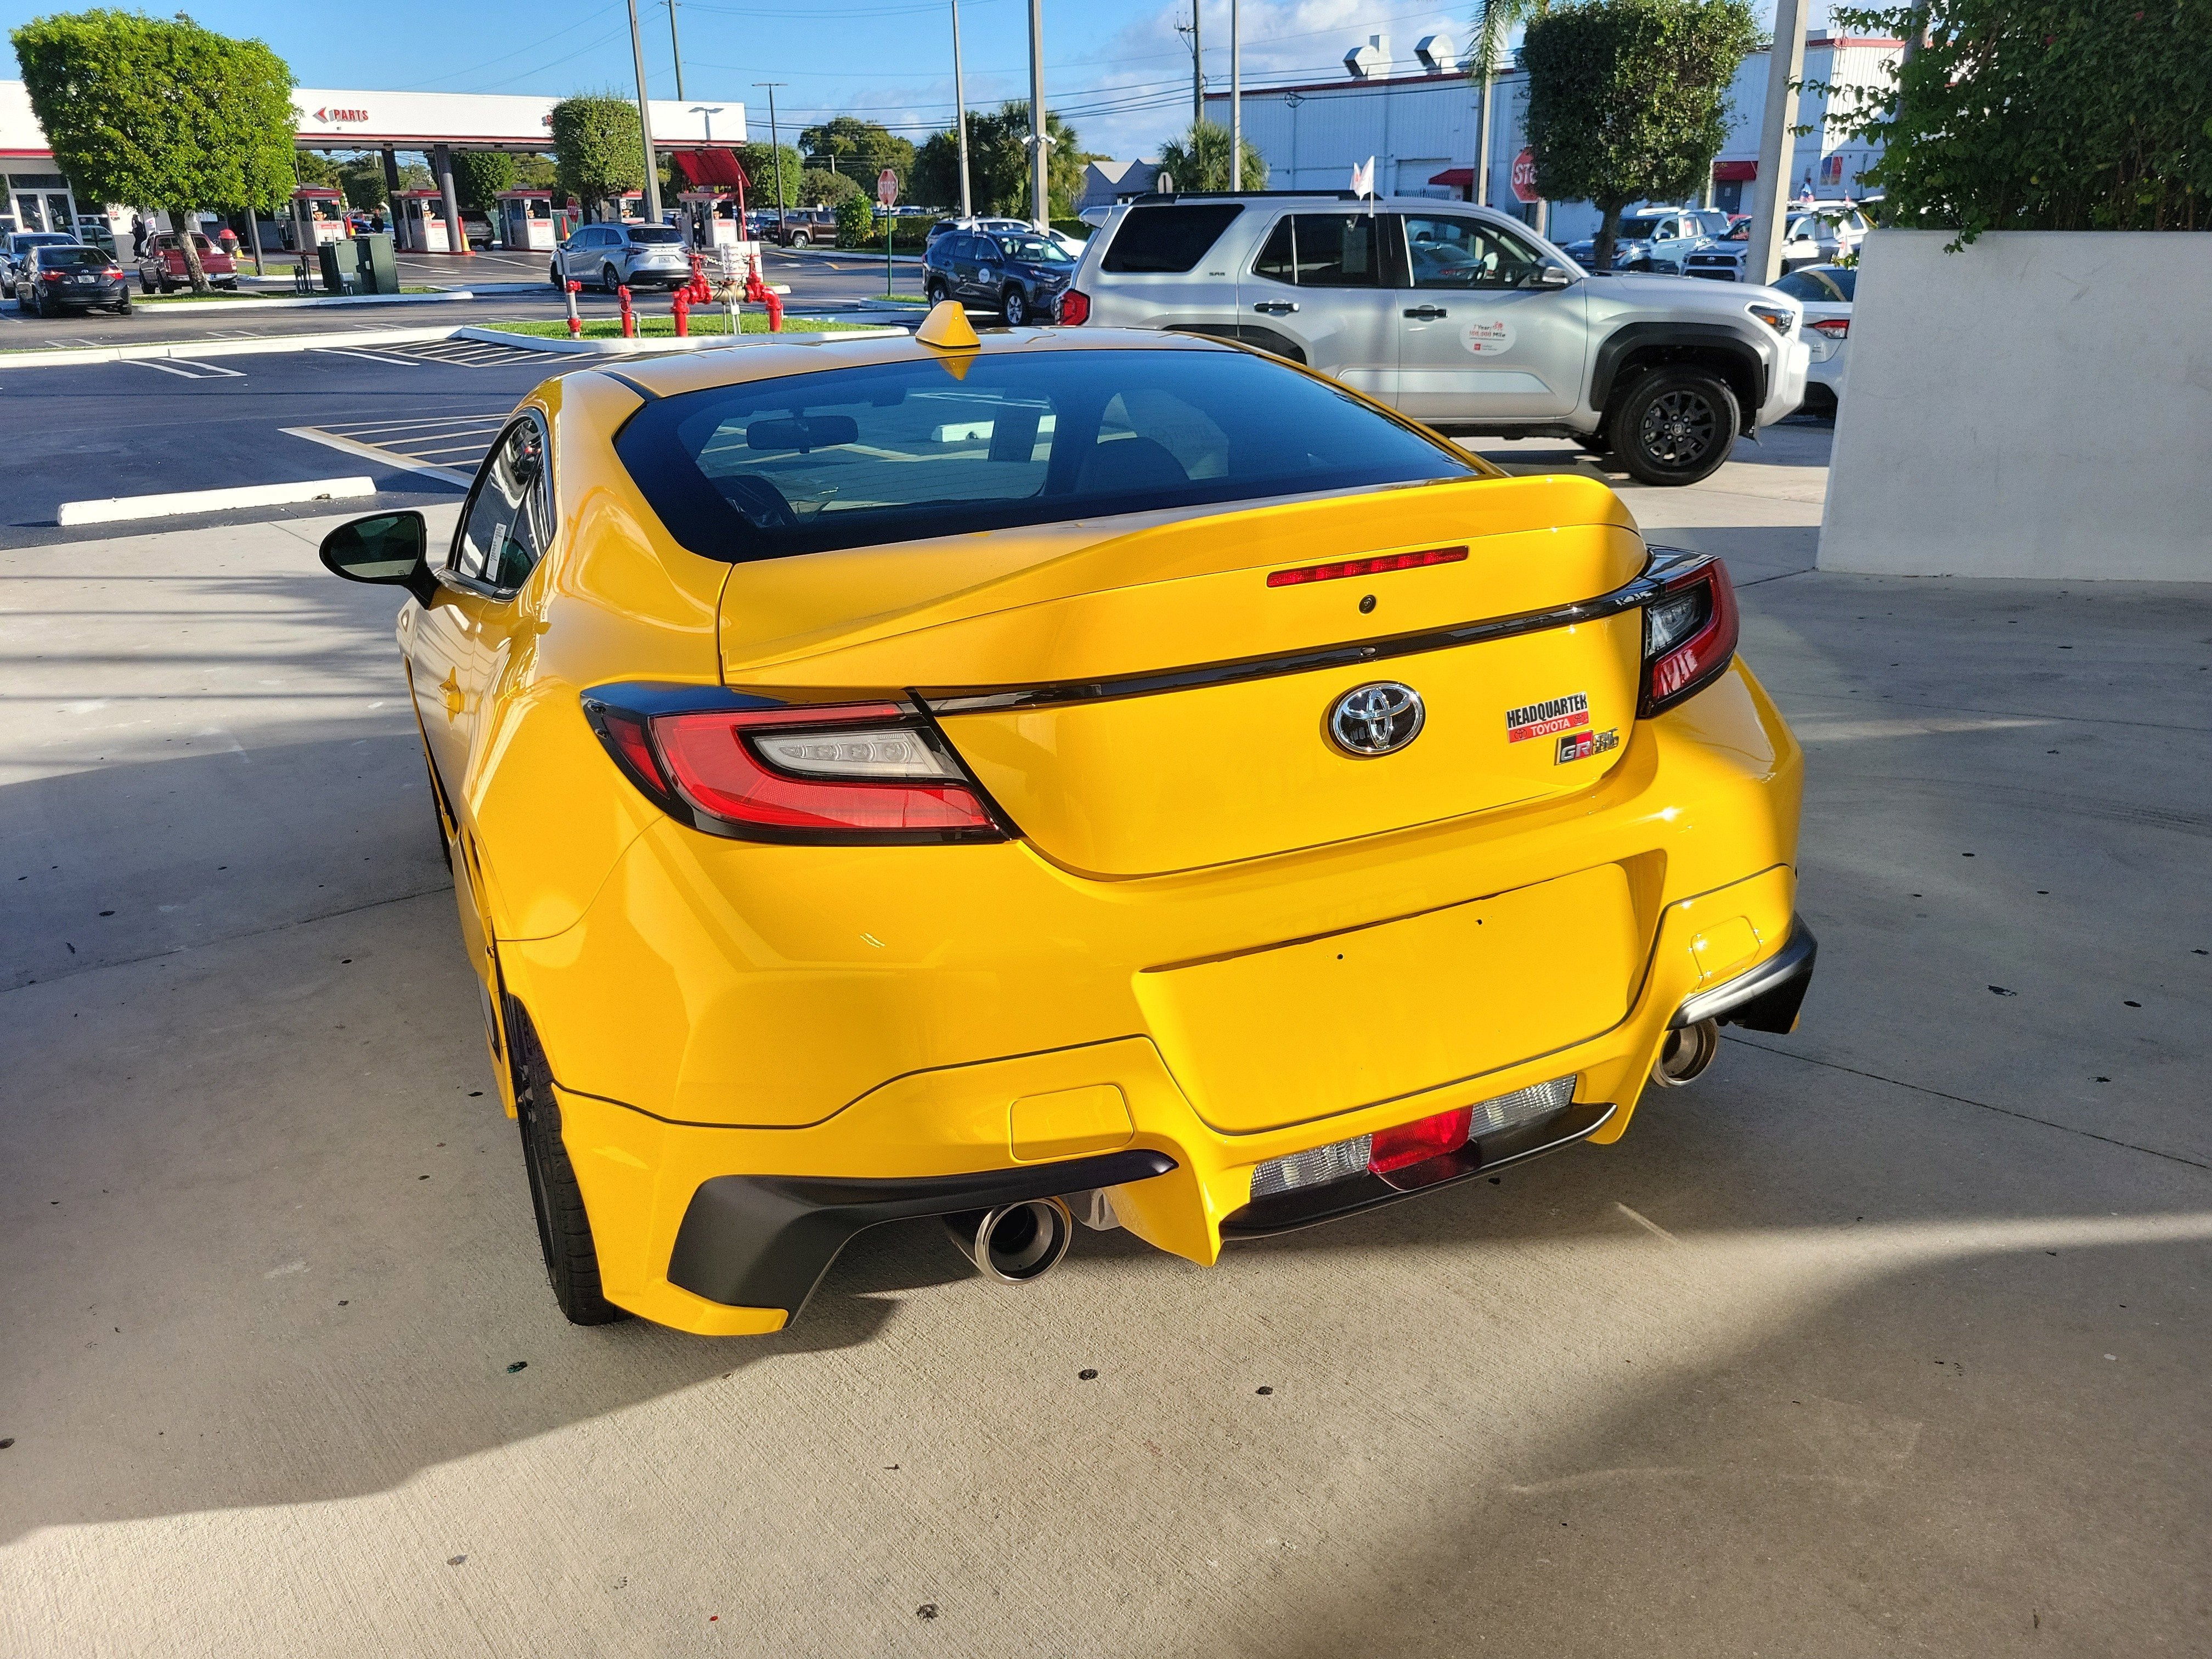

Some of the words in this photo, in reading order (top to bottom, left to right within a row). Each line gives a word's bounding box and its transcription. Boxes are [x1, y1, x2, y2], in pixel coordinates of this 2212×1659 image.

[333, 109, 369, 121] PARTS
[1514, 163, 1538, 185] STO
[879, 181, 896, 195] STOP
[312, 201, 319, 211] 5
[423, 202, 430, 211] 6
[525, 201, 532, 210] 7
[621, 201, 627, 210] 8
[1507, 693, 1587, 729] HEADQUARTER
[1530, 718, 1571, 736] TOYOTA
[1561, 740, 1590, 761] GR
